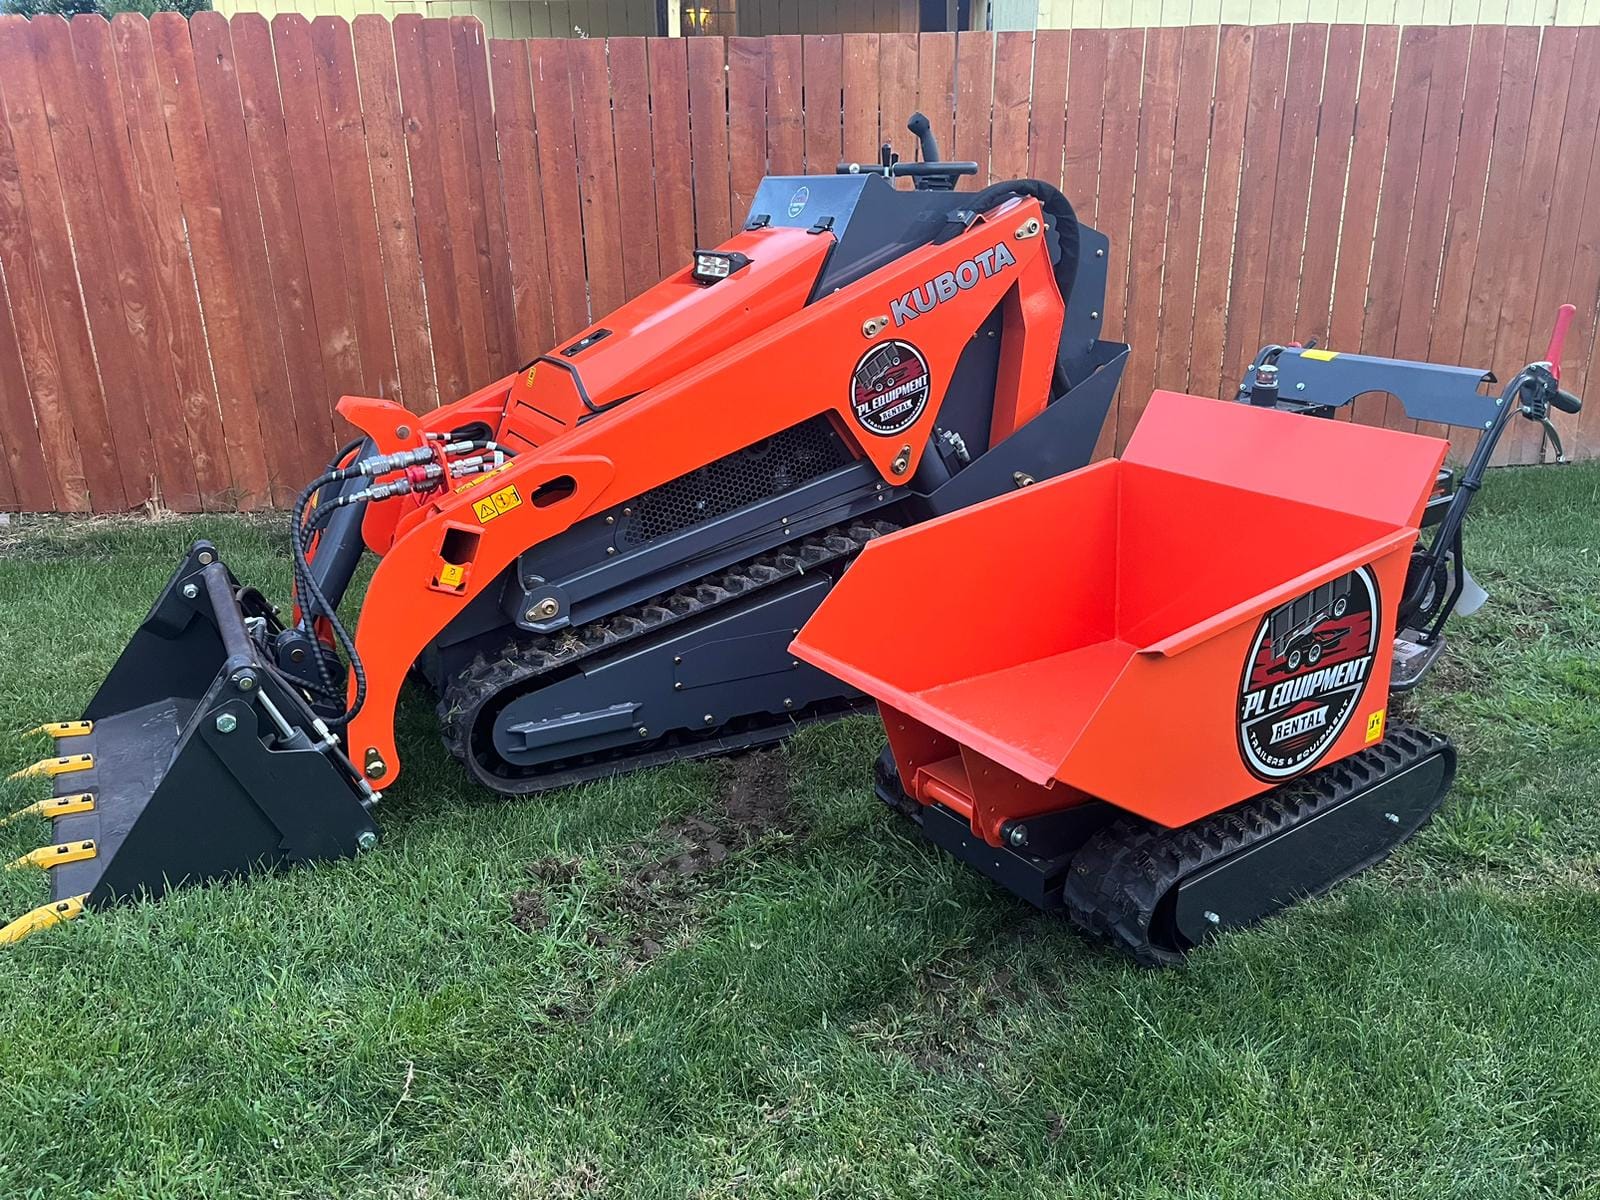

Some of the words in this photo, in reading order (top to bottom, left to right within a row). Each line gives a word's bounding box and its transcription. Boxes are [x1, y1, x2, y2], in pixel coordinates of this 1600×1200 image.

[889, 242, 1016, 327] KUBOTA
[855, 402, 871, 417] PL
[872, 373, 929, 410] EQUIPMENT
[882, 402, 911, 418] RENTAL
[1243, 689, 1266, 720] PL
[1269, 656, 1371, 710] EQUIPMENT
[1275, 709, 1322, 741] RENTAL
[1250, 731, 1284, 767] TRAILERS
